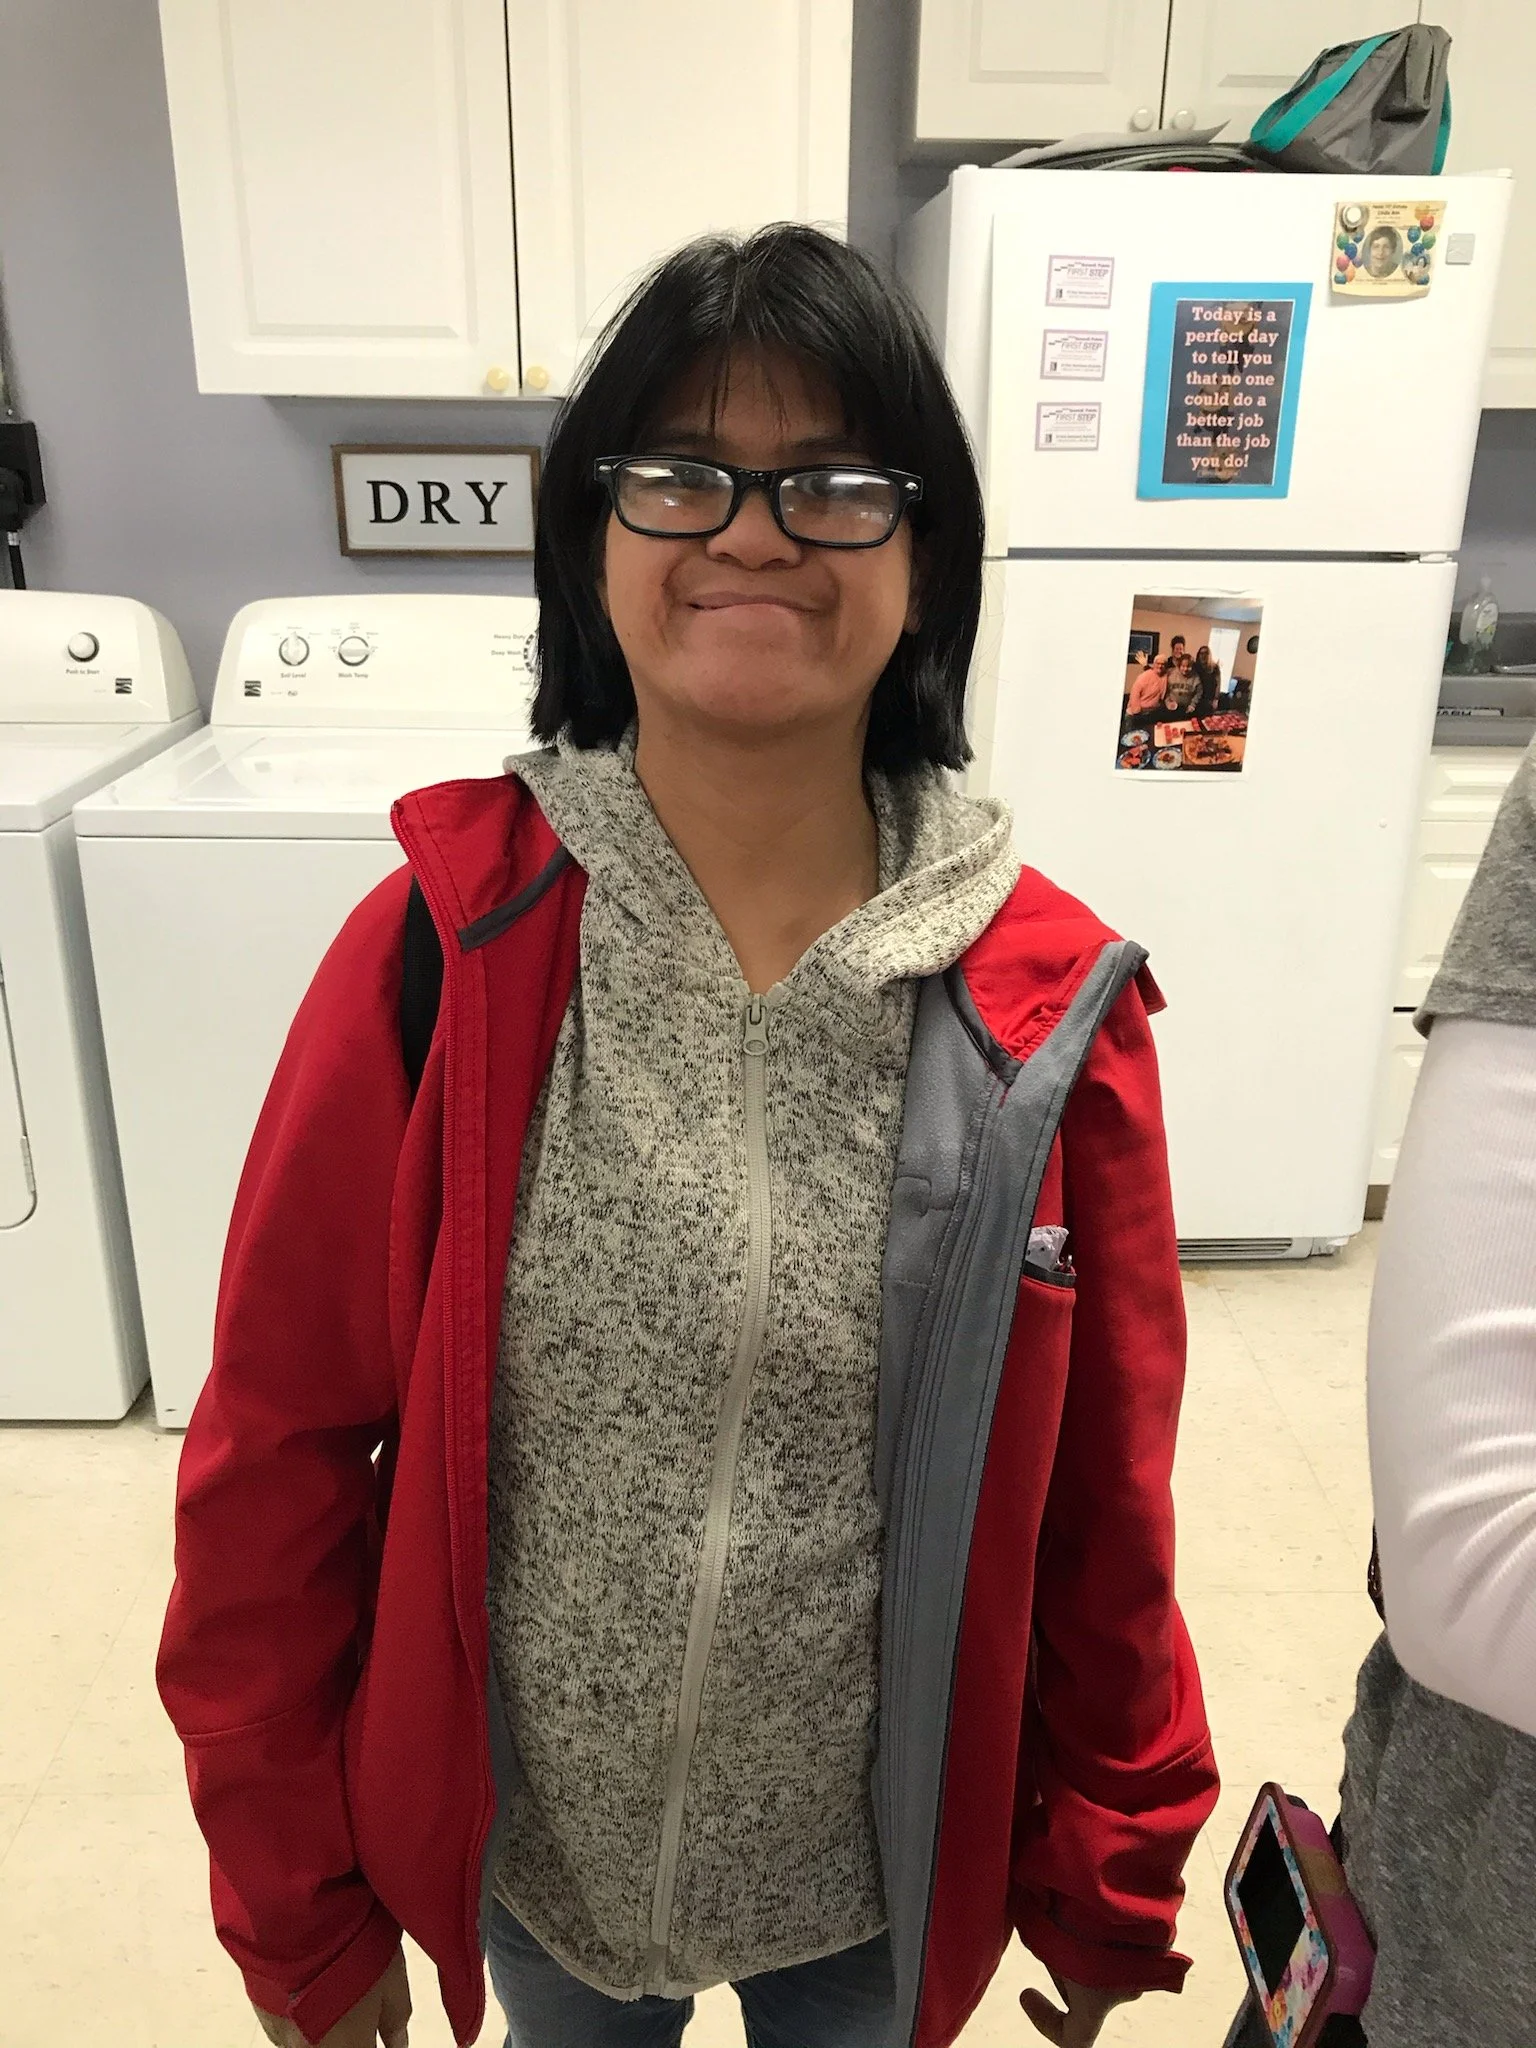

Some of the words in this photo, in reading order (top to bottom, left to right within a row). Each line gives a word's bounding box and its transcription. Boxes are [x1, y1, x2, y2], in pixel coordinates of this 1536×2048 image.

[1067, 267, 1088, 276] FIRST
[1089, 268, 1109, 278] STEP
[1191, 306, 1244, 325] Today
[1247, 307, 1262, 322] is
[1266, 311, 1277, 321] a
[1061, 341, 1082, 350] FIRST
[1083, 342, 1103, 351] STEP
[1184, 328, 1244, 346] perfect
[1247, 329, 1279, 347] day
[1191, 351, 1208, 364] to
[1211, 350, 1239, 364] tell
[1242, 353, 1273, 368] you
[1186, 371, 1218, 385] that
[1221, 374, 1241, 385] no
[1245, 374, 1275, 385] one
[1184, 392, 1229, 406] could
[1233, 393, 1253, 406] do
[1257, 396, 1267, 406] a
[1055, 412, 1077, 421] FIRST
[1077, 413, 1097, 422] STEP
[1186, 412, 1235, 427] better
[1237, 413, 1264, 431] job
[1176, 433, 1212, 447] than
[1215, 433, 1241, 448] the
[1244, 434, 1271, 451] job
[1191, 456, 1220, 471] you
[1224, 454, 1249, 468] do!
[366, 480, 508, 525] DRY
